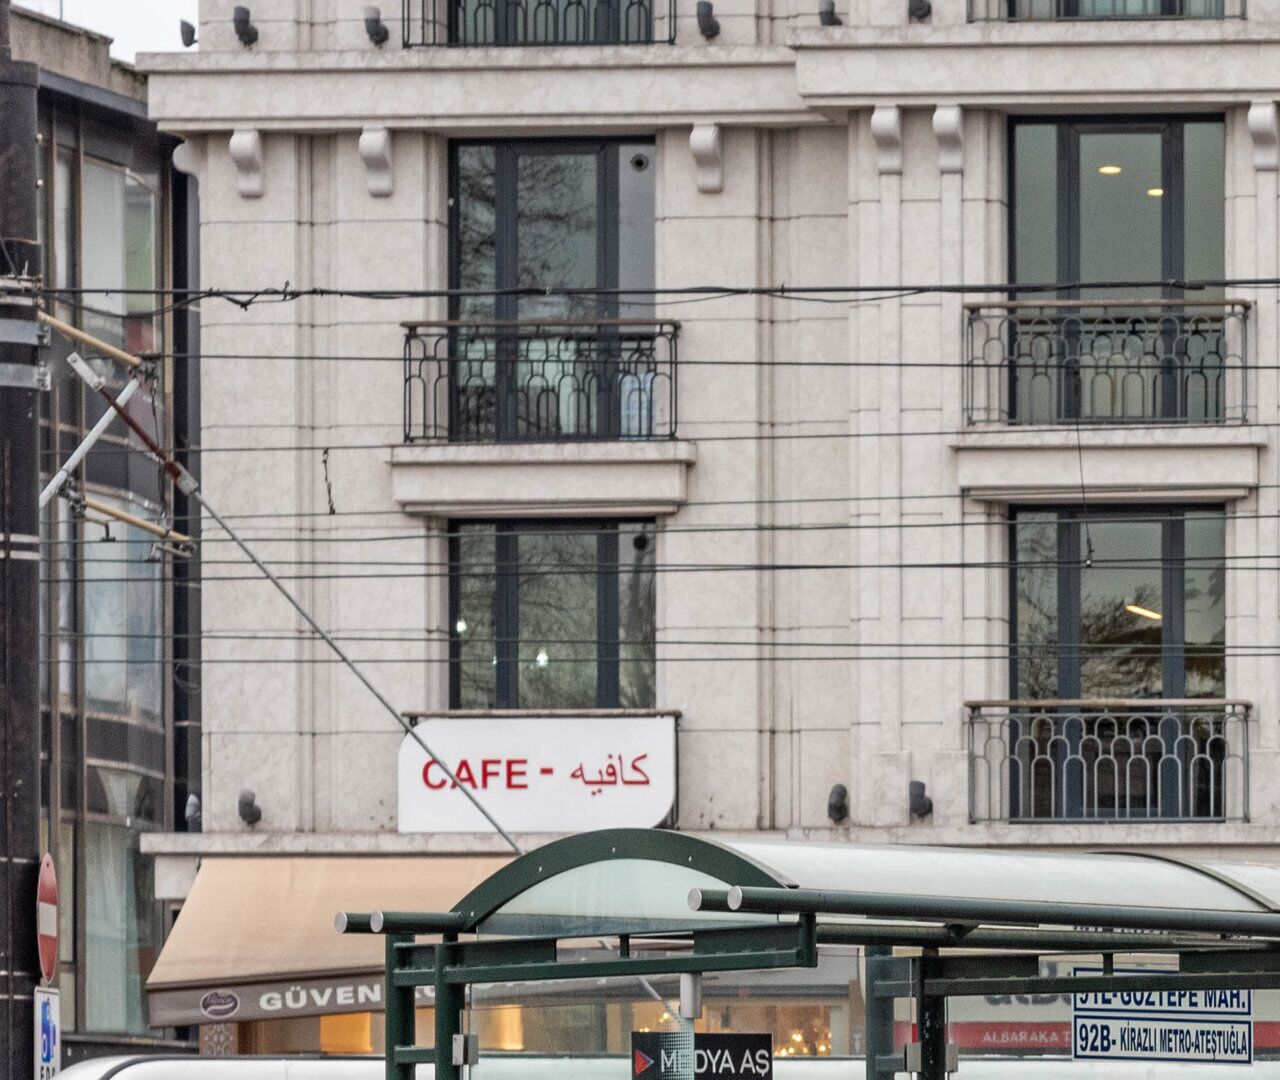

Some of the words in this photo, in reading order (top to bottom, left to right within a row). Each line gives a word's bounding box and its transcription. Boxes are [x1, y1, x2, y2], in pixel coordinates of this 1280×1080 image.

[422, 759, 528, 790] CAFE
[570, 753, 651, 796] كافيه
[259, 983, 381, 1011] GÜVEN
[1119, 1021, 1156, 1052] KİRAZLI
[740, 1050, 770, 1077] AŞ
